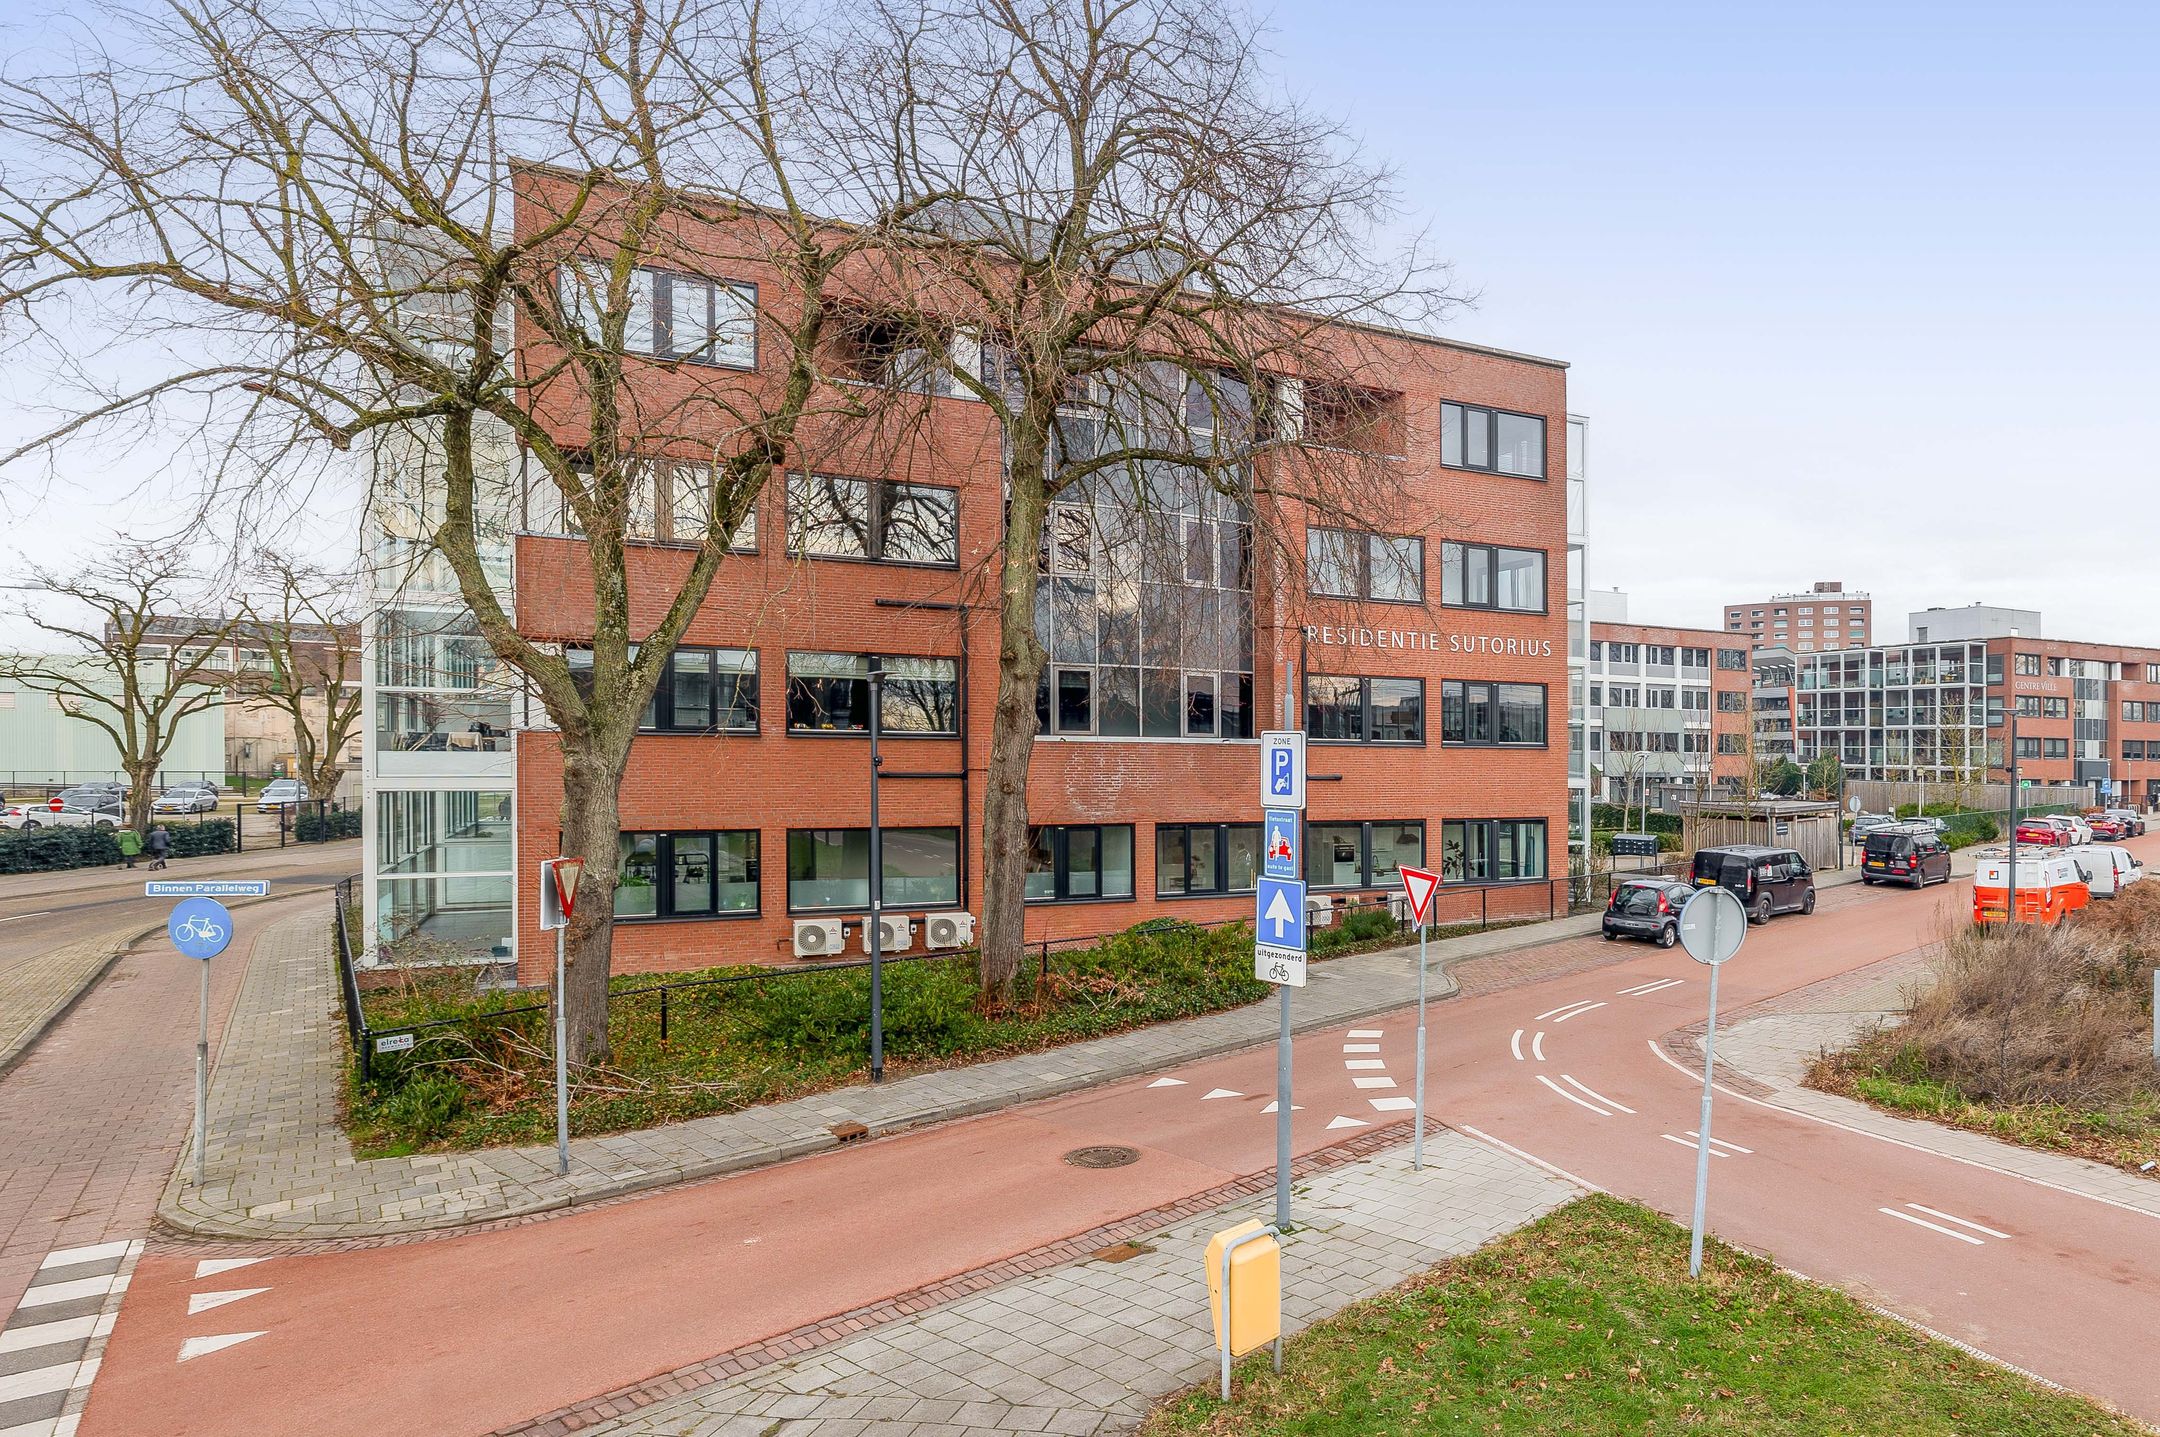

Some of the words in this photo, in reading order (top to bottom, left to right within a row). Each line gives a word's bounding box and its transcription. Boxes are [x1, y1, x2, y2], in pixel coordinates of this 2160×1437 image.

[1307, 625, 1440, 650] RESIDENTIE
[1450, 634, 1552, 657] SUTORIUS
[2015, 680, 2040, 690] CENTRE
[1273, 737, 1291, 746] ZONE
[1275, 750, 1289, 776] P
[153, 884, 193, 892] Binnen
[195, 884, 259, 894] Parallelweg
[1257, 947, 1303, 963] uitgezonderd
